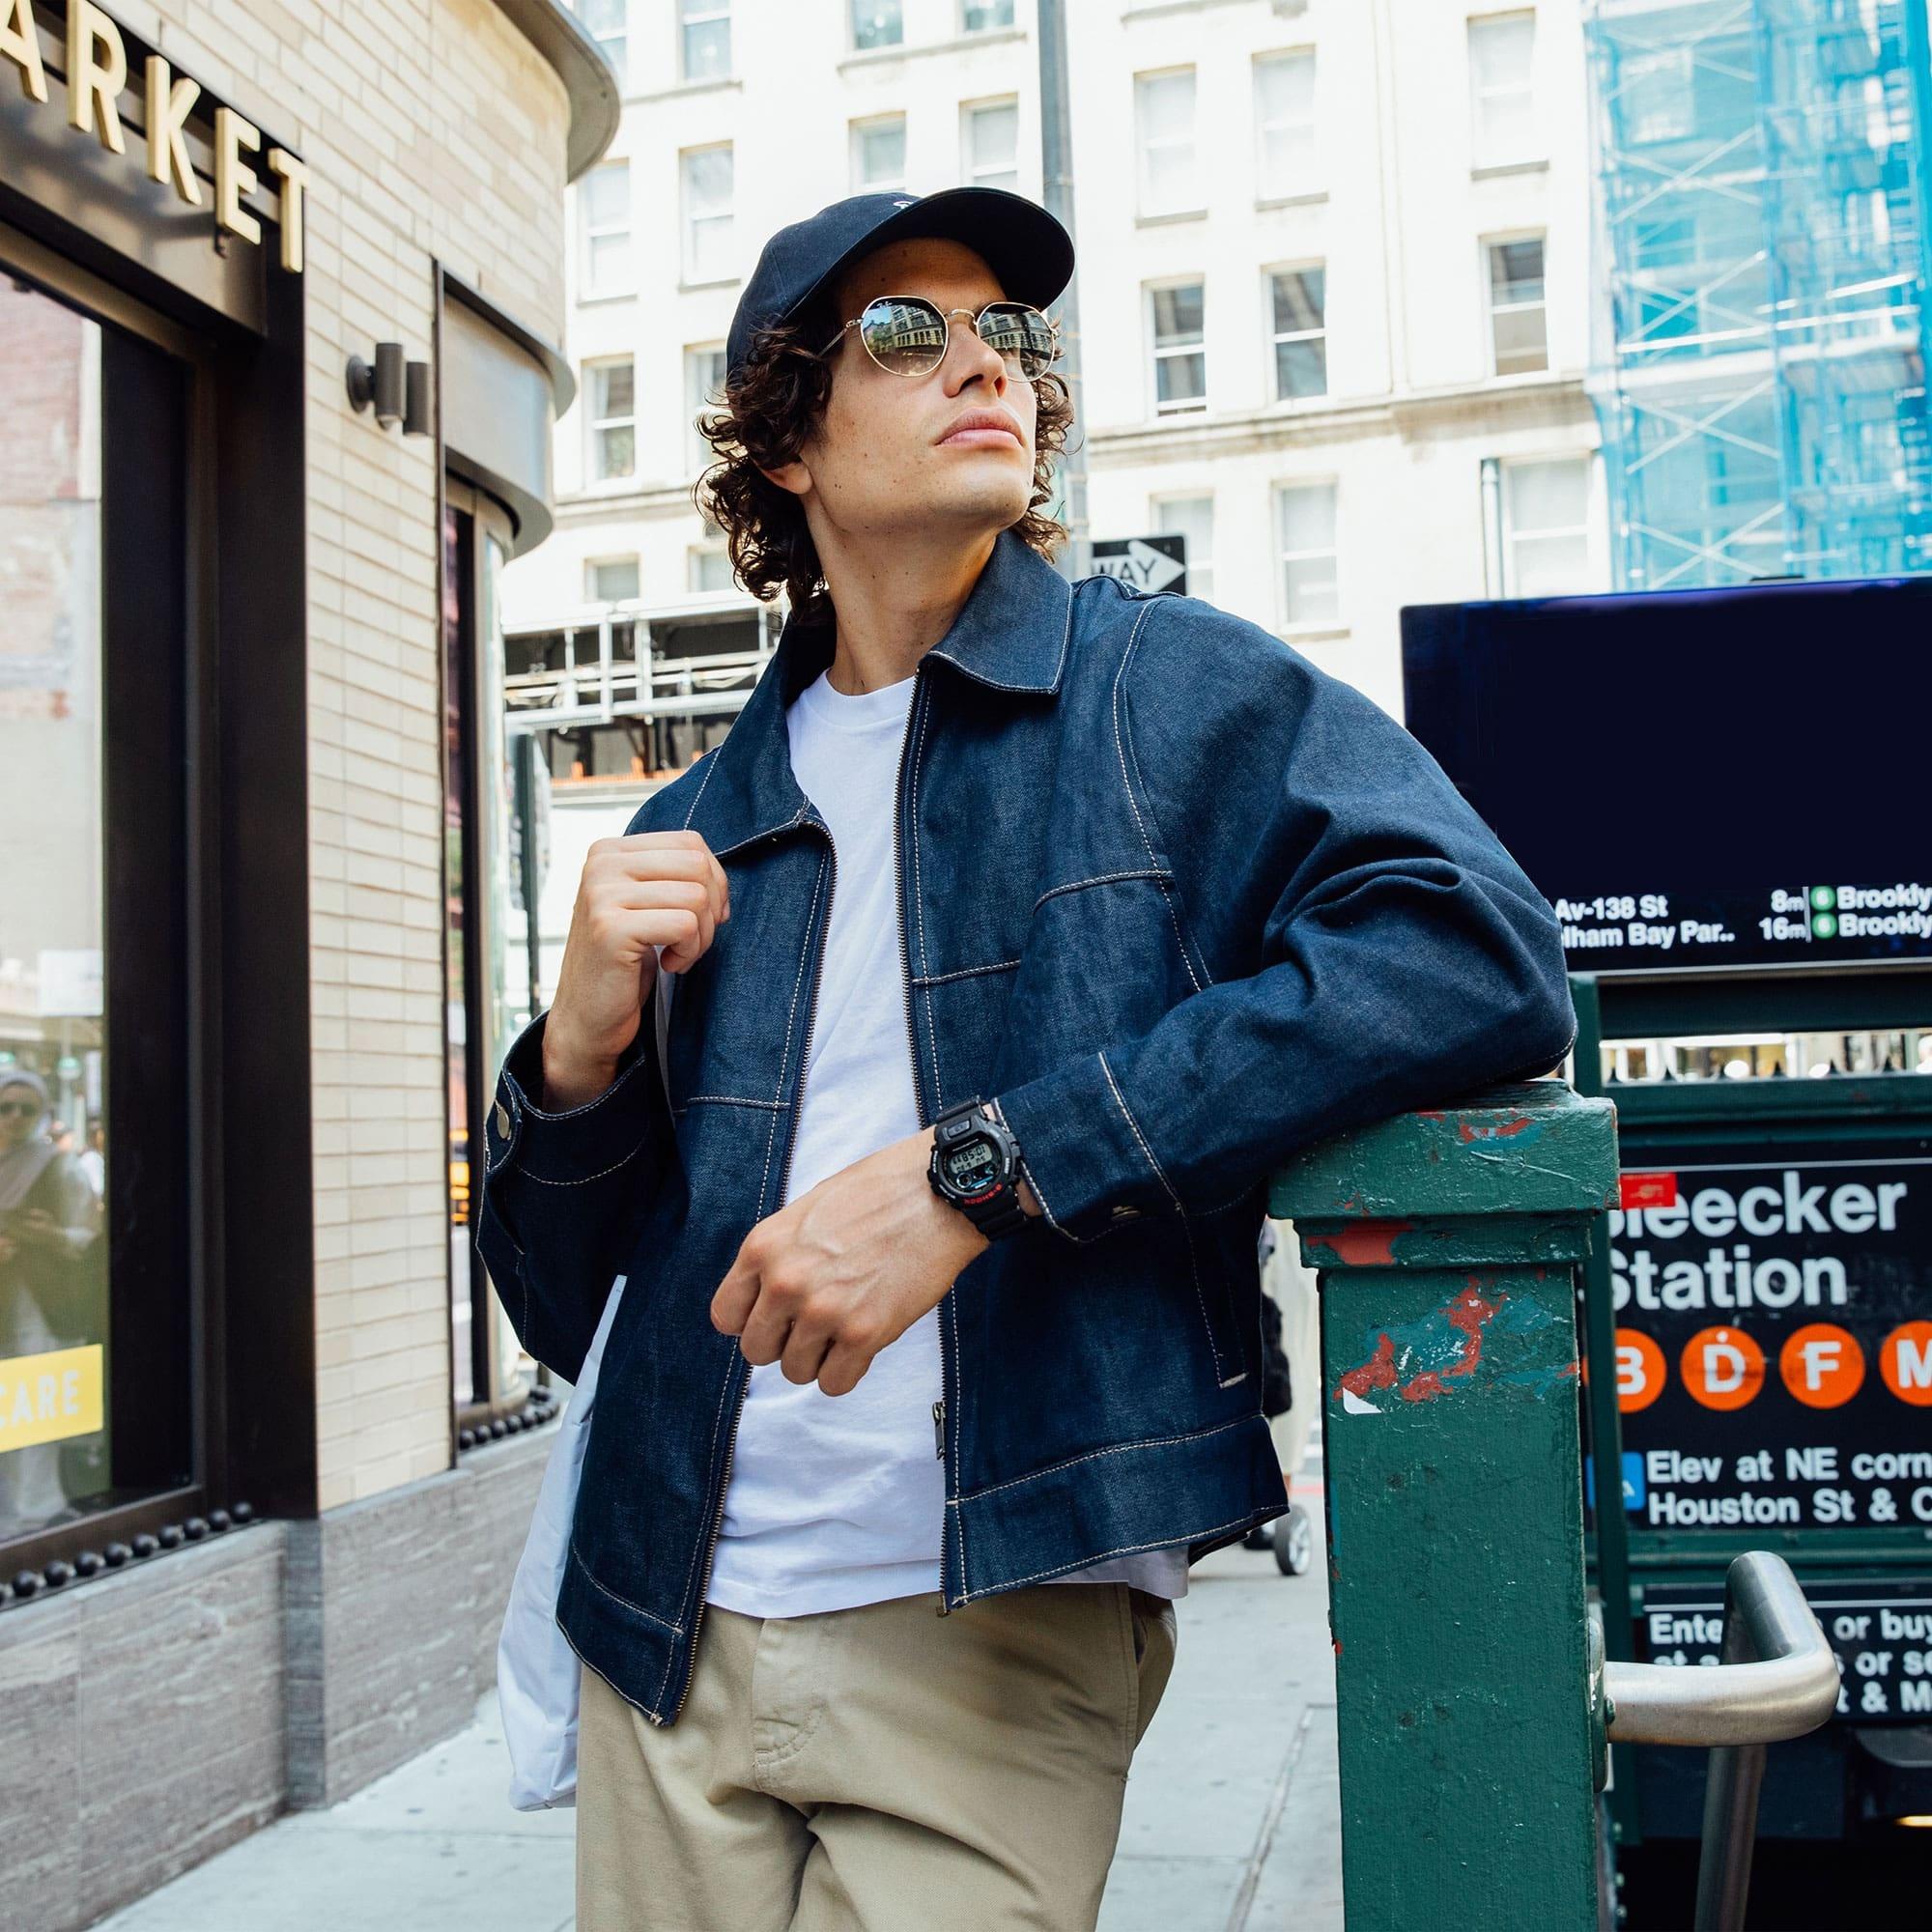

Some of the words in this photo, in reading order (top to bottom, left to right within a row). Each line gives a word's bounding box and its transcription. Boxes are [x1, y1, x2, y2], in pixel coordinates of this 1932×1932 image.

[1555, 896, 1636, 921] Av-138
[1639, 894, 1669, 918] St
[1771, 889, 1804, 913] 8m
[1561, 924, 1624, 949] lham
[1628, 922, 1676, 950] Bay
[1680, 920, 1735, 943] Par..
[1758, 917, 1806, 941] 16m
[1608, 1171, 1908, 1239] eecker
[1615, 1347, 1646, 1395] B
[1702, 1344, 1746, 1393] D
[1804, 1341, 1841, 1390] F
[1896, 1339, 1932, 1389] M
[1646, 1450, 1722, 1483] Elev
[1736, 1450, 1774, 1482] at
[1786, 1447, 1839, 1481] NE
[1851, 1452, 1932, 1480] corn
[1648, 1492, 1800, 1524] Houston
[1813, 1488, 1856, 1522] St
[1868, 1487, 1898, 1521] &
[1833, 1615, 1871, 1640] or
[1855, 1651, 1893, 1677] or
[1861, 1681, 1889, 1713] &
